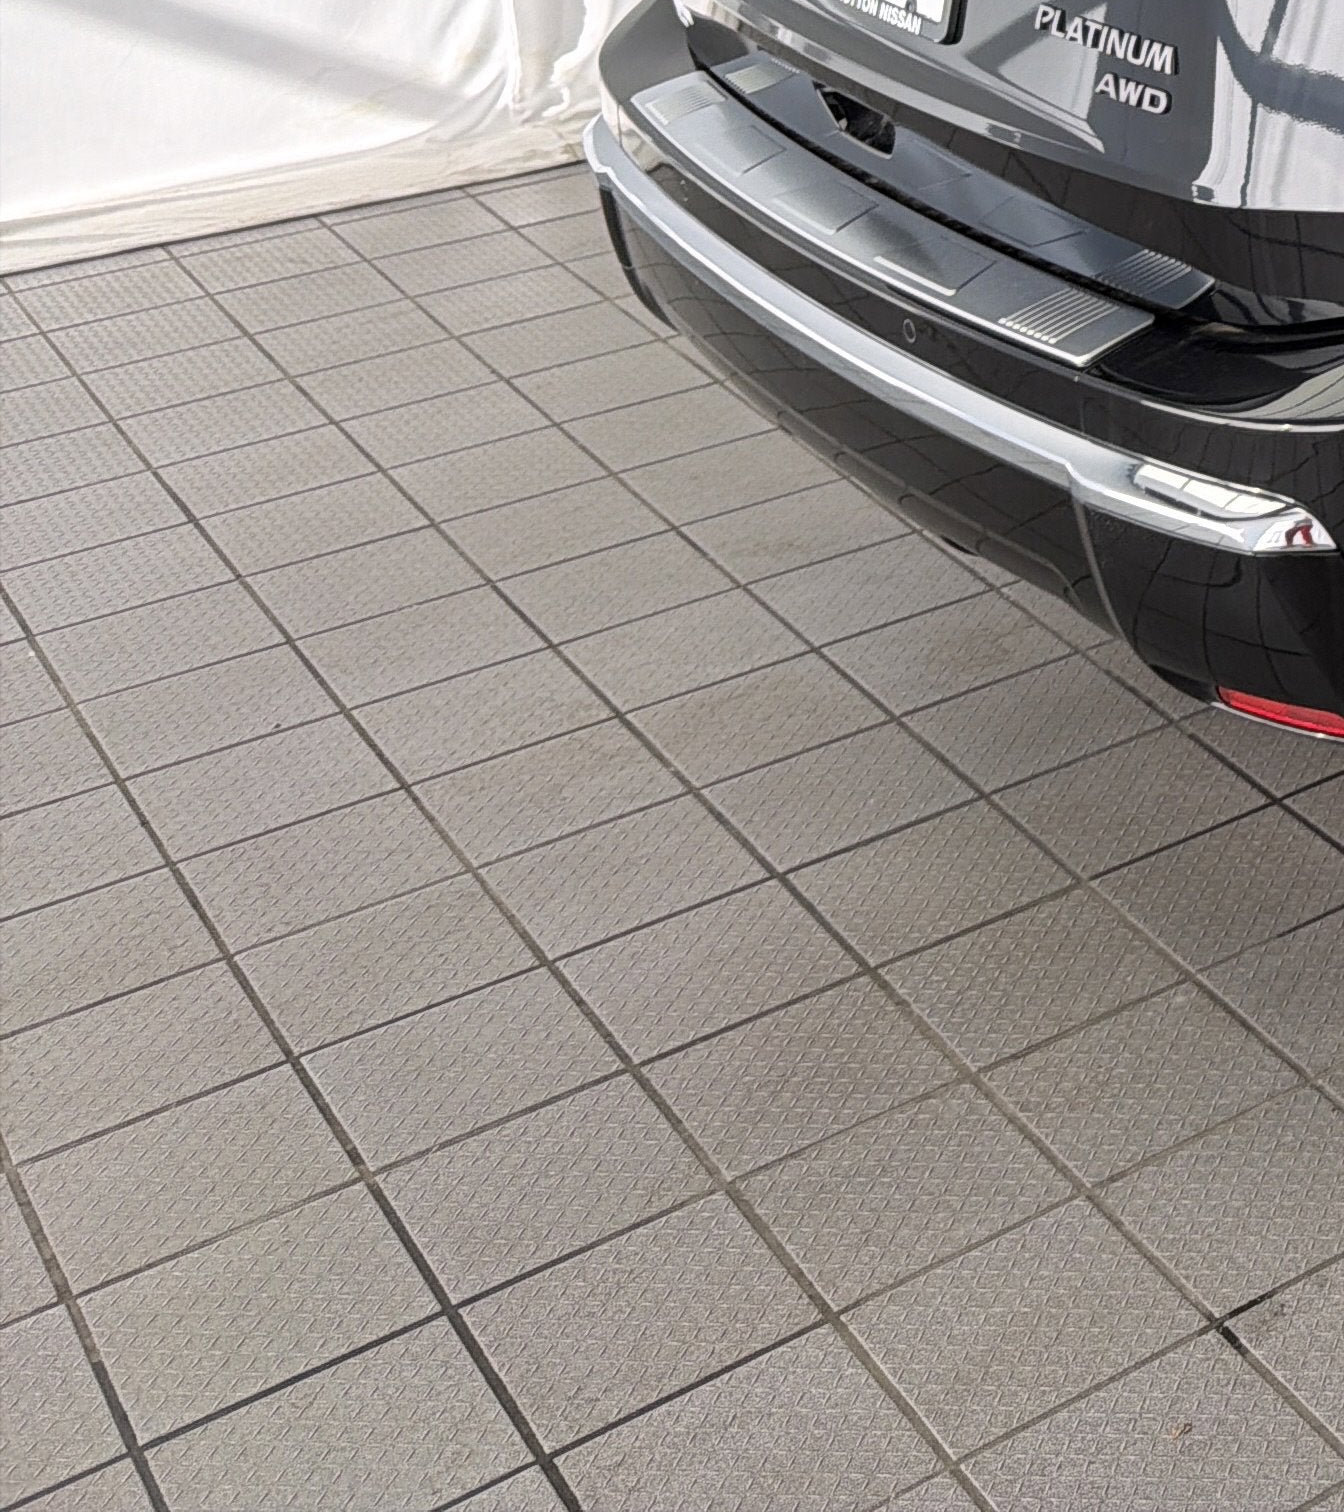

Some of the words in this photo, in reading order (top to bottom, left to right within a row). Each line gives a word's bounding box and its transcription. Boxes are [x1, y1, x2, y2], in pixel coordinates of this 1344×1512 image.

[878, 0, 922, 35] NISSAN
[1034, 3, 1178, 75] PLATINUM
[1094, 72, 1172, 115] AWD
